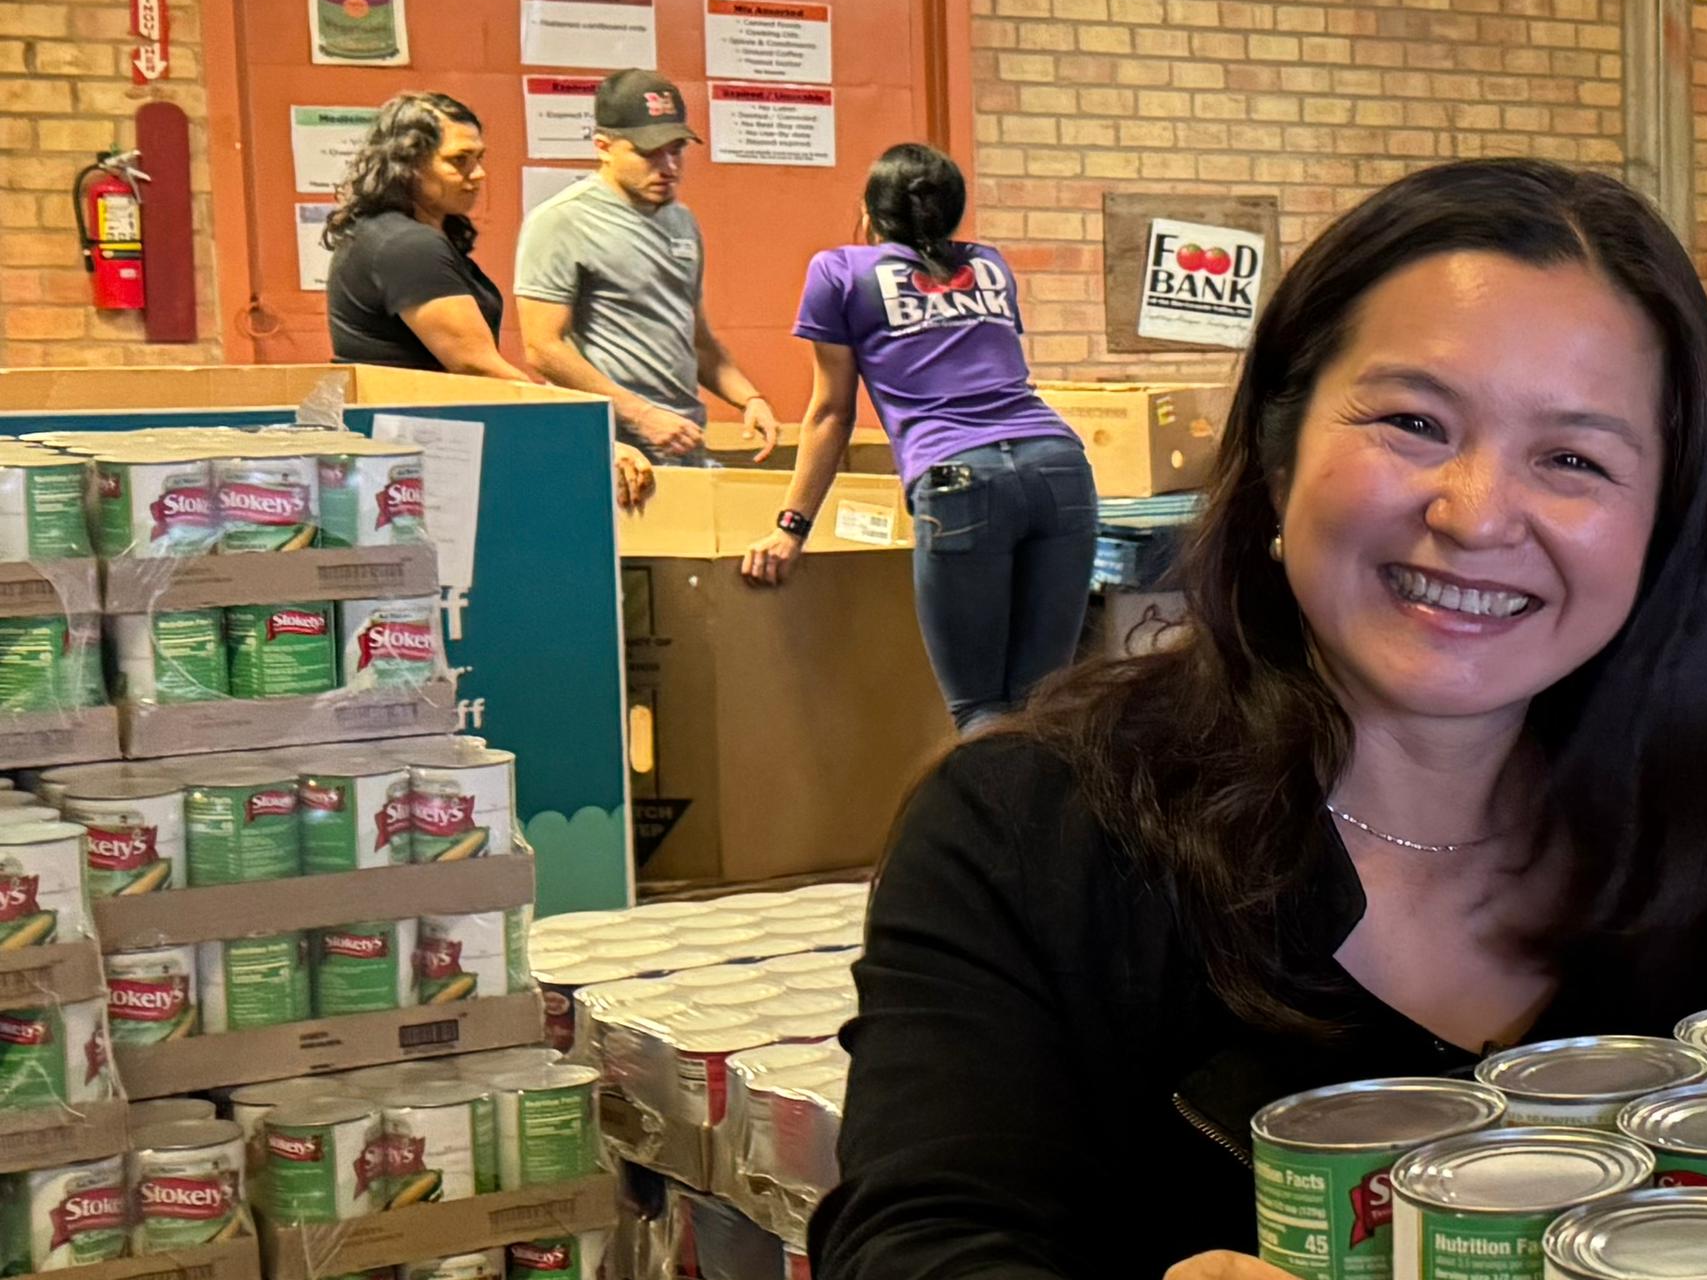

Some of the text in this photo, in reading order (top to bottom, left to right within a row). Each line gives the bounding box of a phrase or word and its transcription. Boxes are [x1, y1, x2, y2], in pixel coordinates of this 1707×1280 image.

[1149, 268, 1253, 306] BANK
[883, 290, 1012, 327] BANK
[1284, 1170, 1325, 1191] Facts
[1304, 1231, 1329, 1256] 45
[1434, 1232, 1511, 1256] Nutrition
